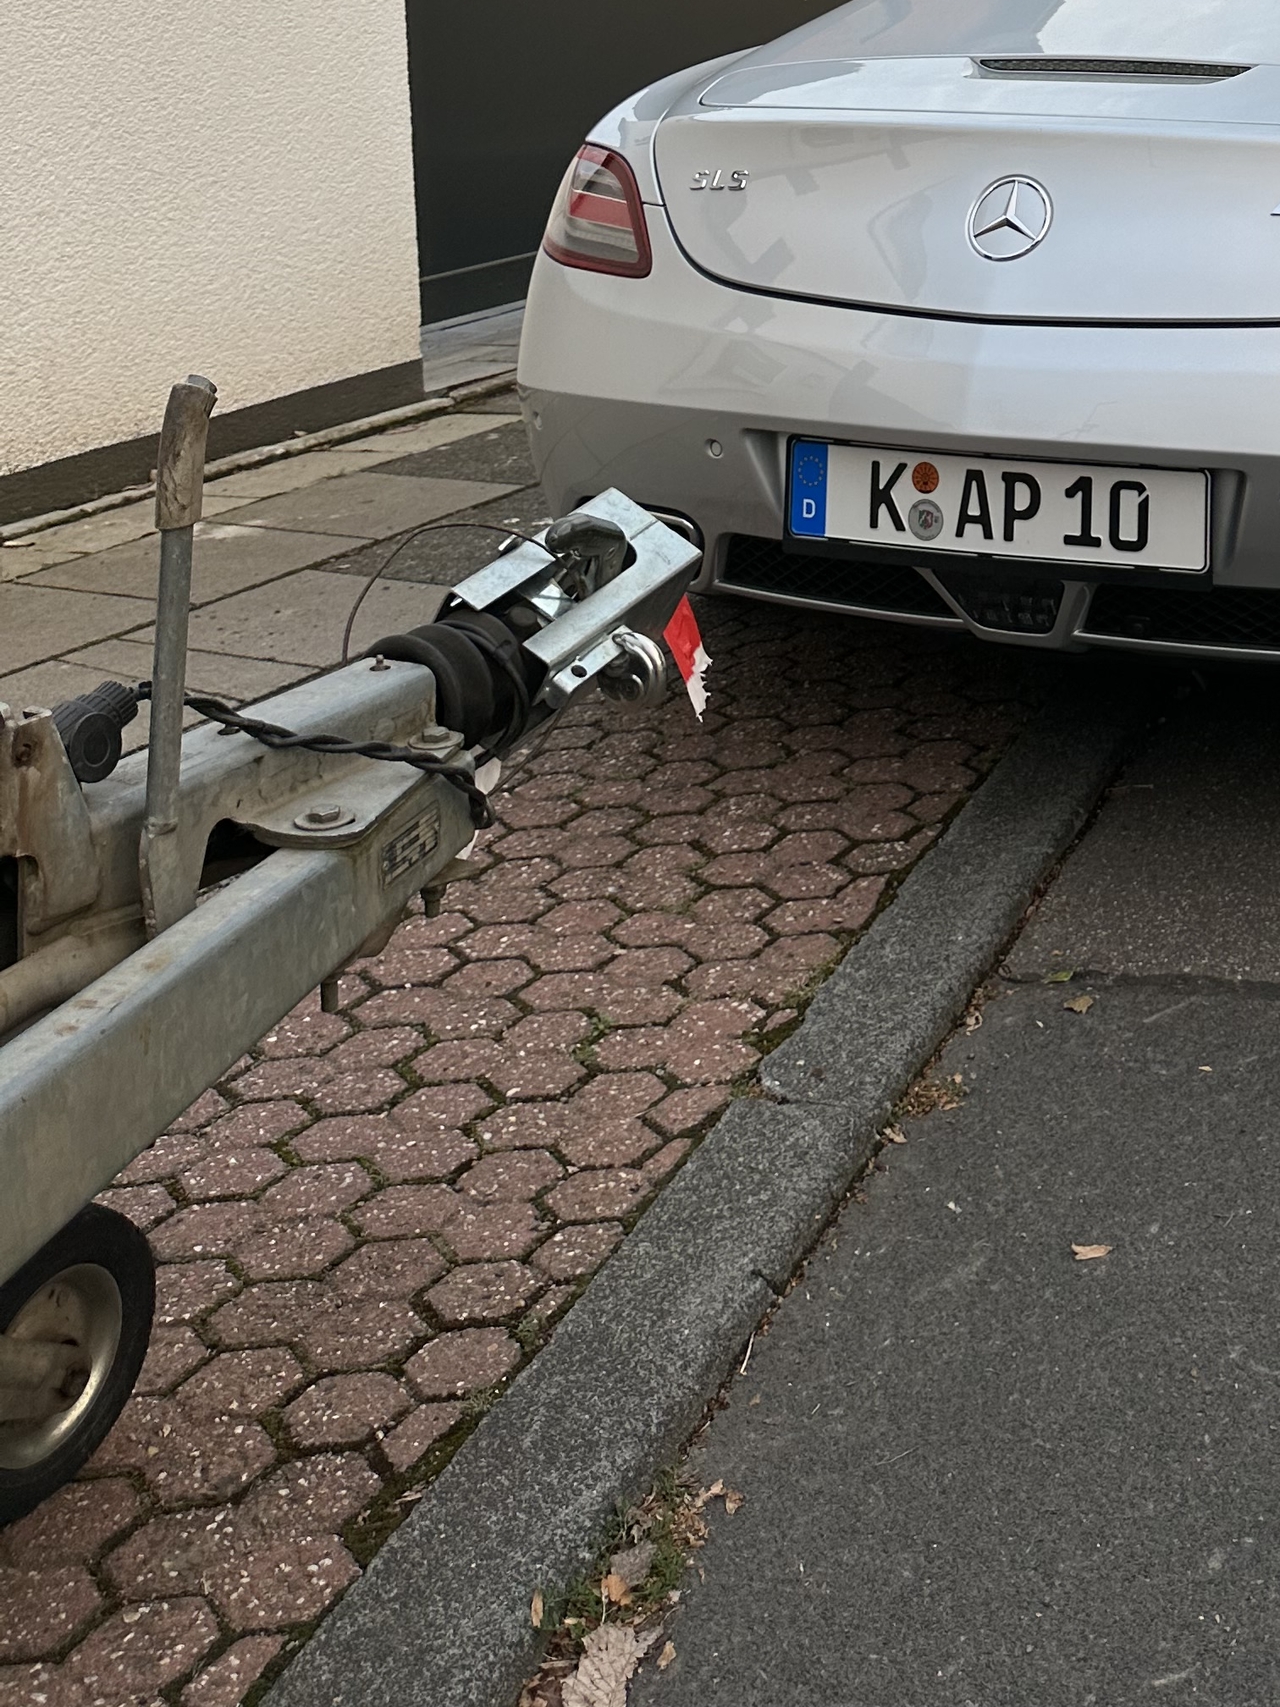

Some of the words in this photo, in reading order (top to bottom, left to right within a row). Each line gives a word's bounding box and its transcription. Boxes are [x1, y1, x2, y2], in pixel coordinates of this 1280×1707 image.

[689, 169, 749, 191] SLS
[802, 499, 816, 519] D
[869, 460, 908, 532] K
[955, 468, 1041, 542] AP
[1063, 476, 1150, 552] 10
